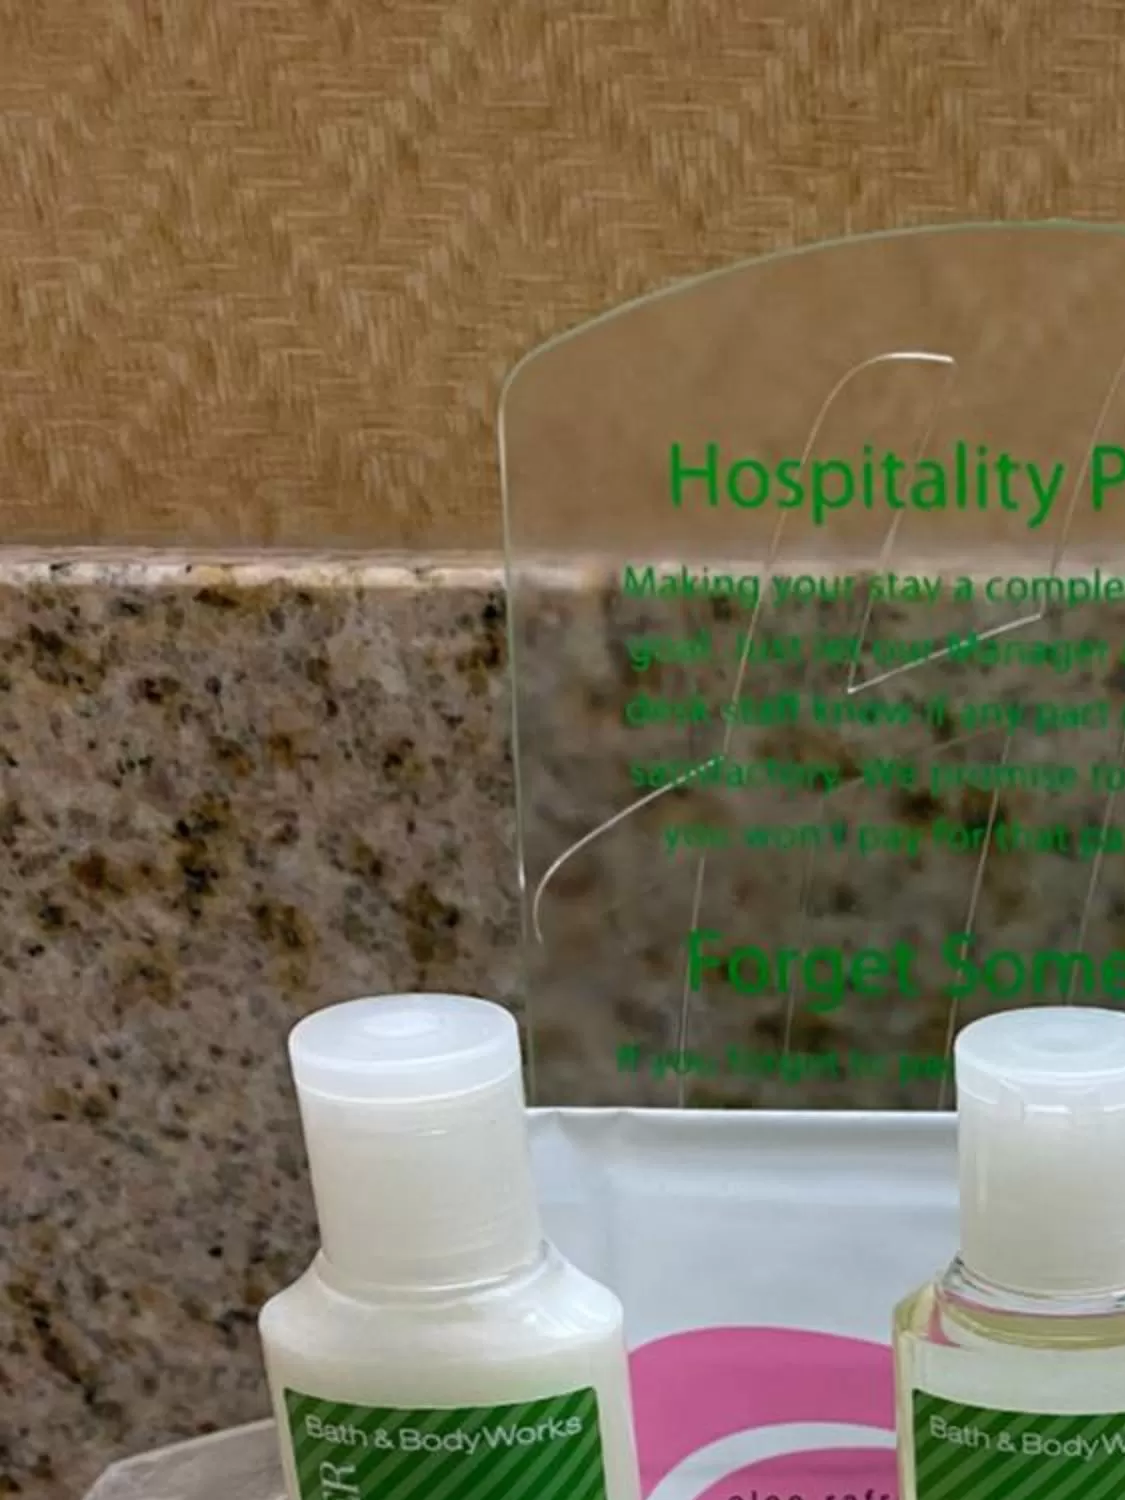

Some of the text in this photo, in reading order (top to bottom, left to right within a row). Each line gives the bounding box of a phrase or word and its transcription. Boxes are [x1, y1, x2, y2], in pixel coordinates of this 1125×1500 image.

[669, 441, 1064, 528] Hospitality
[623, 565, 760, 609] Making
[771, 573, 857, 609] your
[868, 569, 942, 610] stay
[953, 573, 974, 602] a
[945, 631, 1109, 674] Manager
[811, 696, 913, 728] know
[959, 702, 1024, 736] any
[1034, 700, 1110, 734] part
[862, 759, 917, 788] We
[929, 761, 1078, 796] promise
[857, 826, 922, 858] pay
[932, 820, 986, 854] for
[994, 820, 1070, 854] that
[685, 928, 921, 1014] Forget
[304, 1414, 369, 1449] Bath
[373, 1427, 396, 1450] &
[929, 1415, 991, 1452] Bath
[995, 1432, 1019, 1454] &
